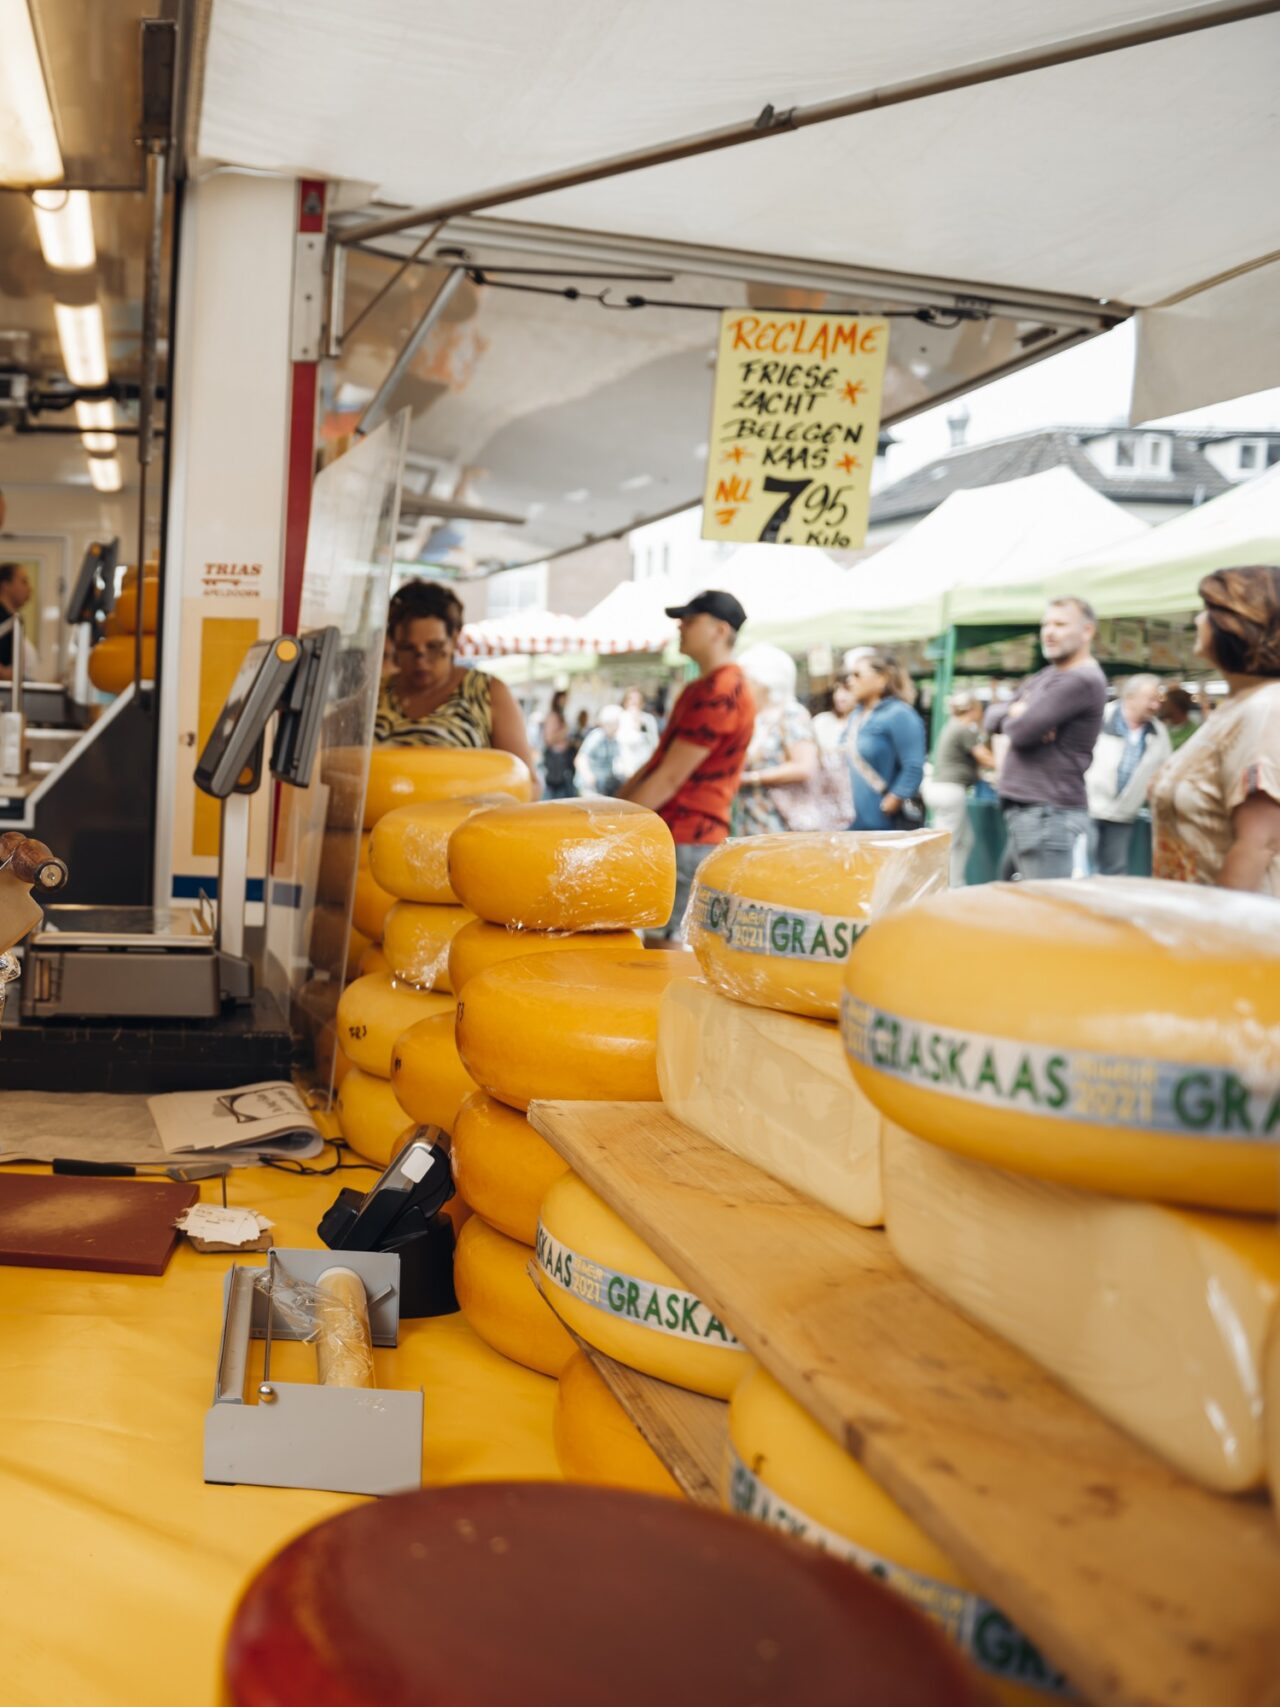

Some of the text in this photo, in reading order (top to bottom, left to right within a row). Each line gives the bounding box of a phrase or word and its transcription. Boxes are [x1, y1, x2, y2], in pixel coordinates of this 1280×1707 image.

[727, 316, 885, 361] RECLAME
[739, 358, 839, 390] FRIESE
[732, 389, 829, 416] ZACHT
[720, 418, 864, 445] BELEGEN
[761, 445, 830, 470] KAAS
[715, 473, 752, 504] NU
[204, 562, 262, 577] TRIAS
[871, 1015, 1070, 1110] GRASKAAS
[607, 1275, 739, 1344] GRASKA
